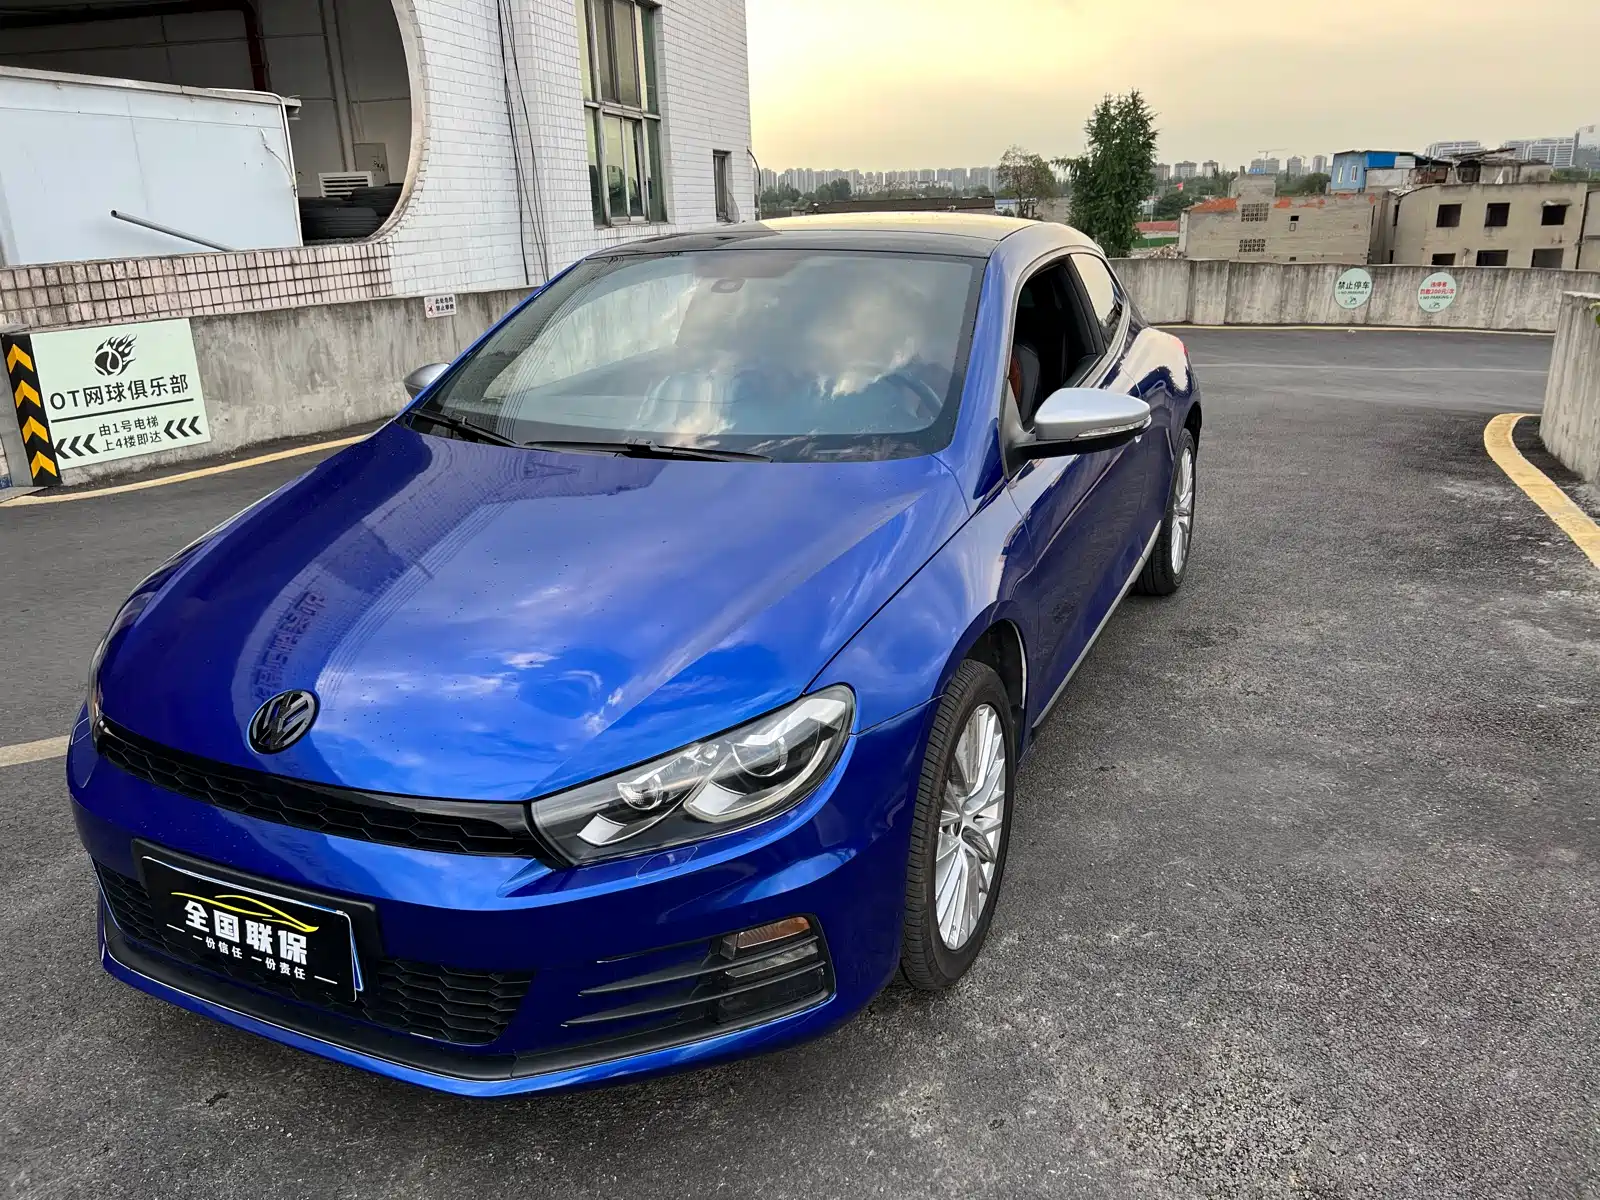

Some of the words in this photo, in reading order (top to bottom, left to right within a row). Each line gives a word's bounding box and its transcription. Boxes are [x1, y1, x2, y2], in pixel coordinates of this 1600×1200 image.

[1337, 281, 1370, 290] 禁止停车
[50, 373, 189, 410] OT网球俱乐部
[98, 415, 159, 437] 由1号电梯
[103, 431, 162, 452] 上4楼即达
[184, 900, 308, 965] 全国联保
[193, 935, 243, 960] 一份信任
[251, 956, 306, 980] 一份责任
